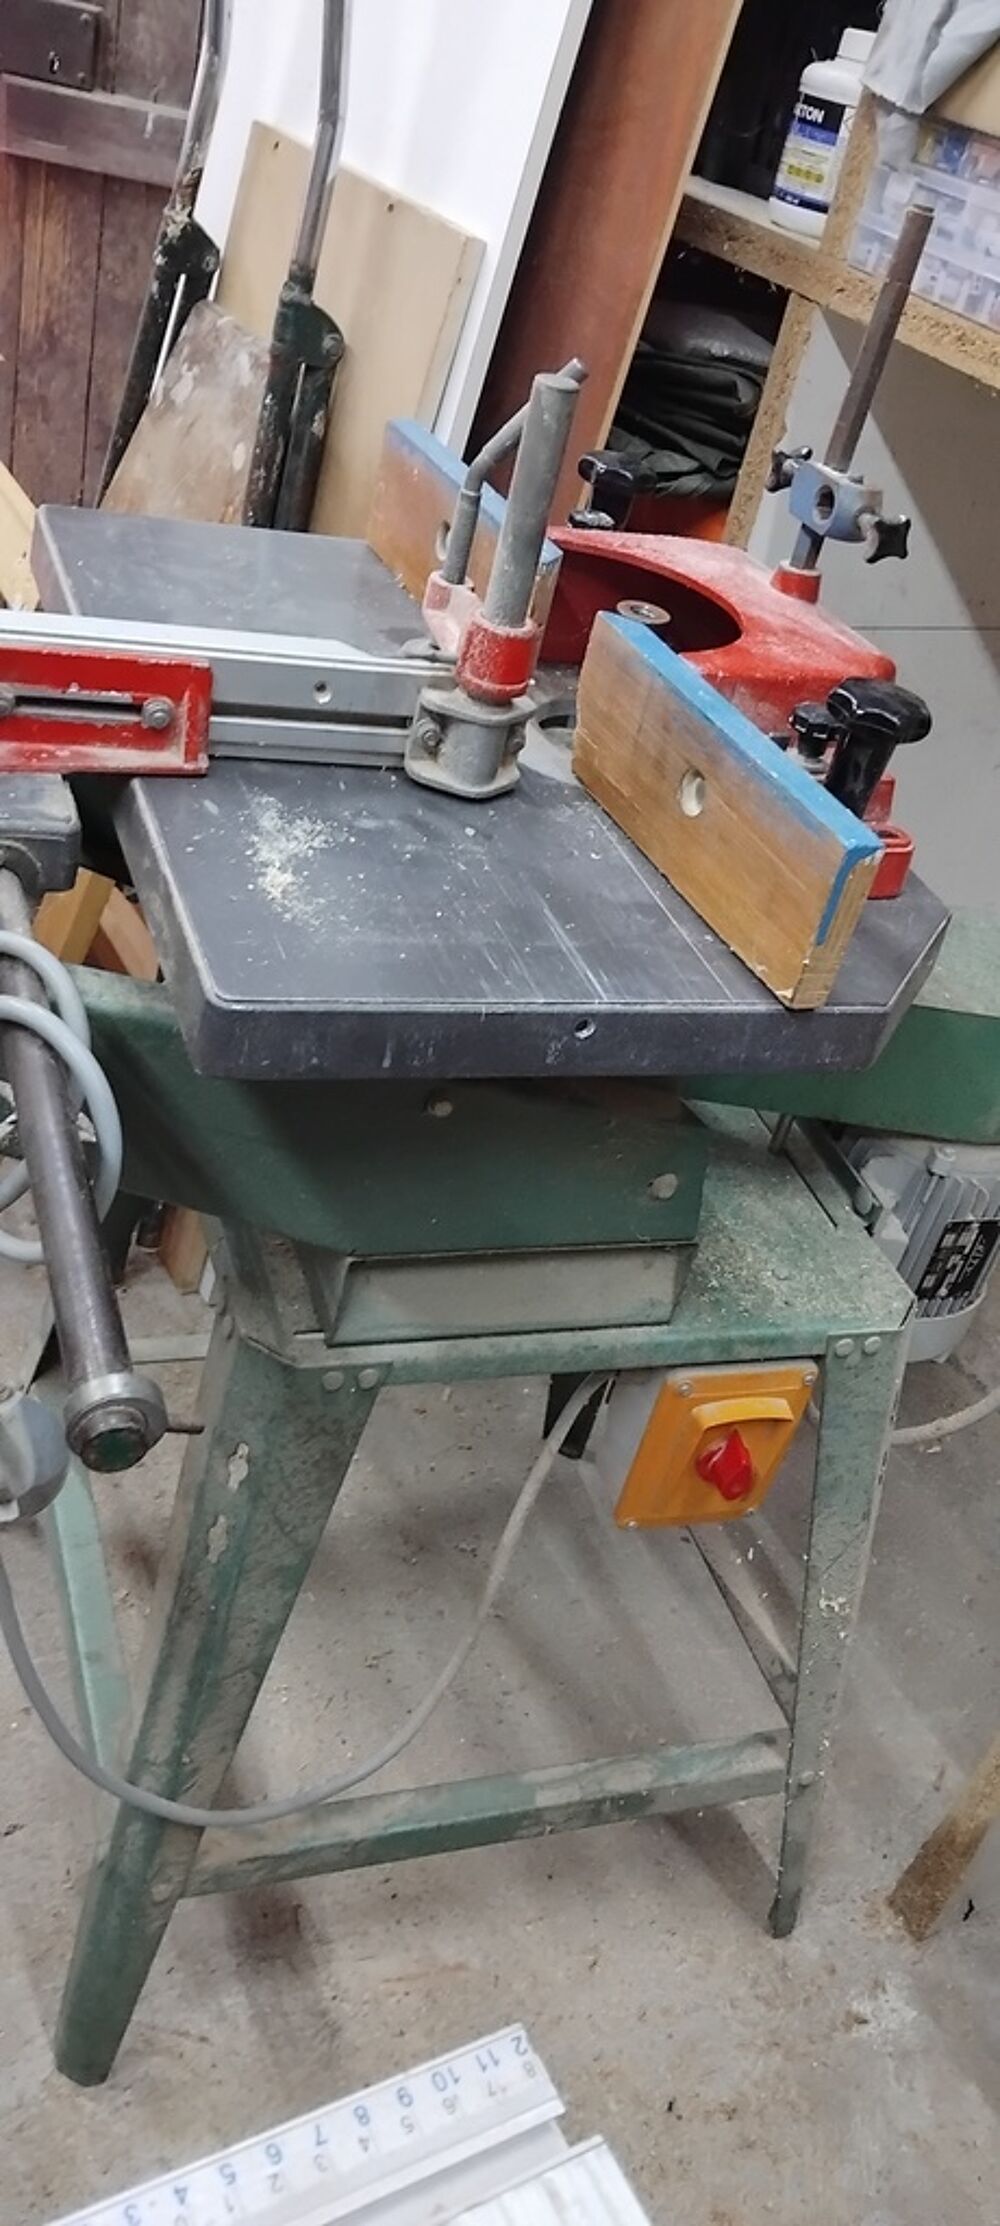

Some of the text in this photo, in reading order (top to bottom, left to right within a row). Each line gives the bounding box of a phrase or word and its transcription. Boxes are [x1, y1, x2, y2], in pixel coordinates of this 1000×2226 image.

[475, 2048, 501, 2074] 11
[431, 2066, 462, 2093] 10
[396, 2086, 414, 2108] 9
[353, 2105, 370, 2127] 8
[314, 2123, 329, 2147] 7
[265, 2143, 282, 2166] 6
[312, 2152, 329, 2173] 3
[218, 2162, 237, 2186] 5
[266, 2172, 285, 2194] 2
[173, 2186, 189, 2206] 4
[123, 2203, 142, 2226] 3
